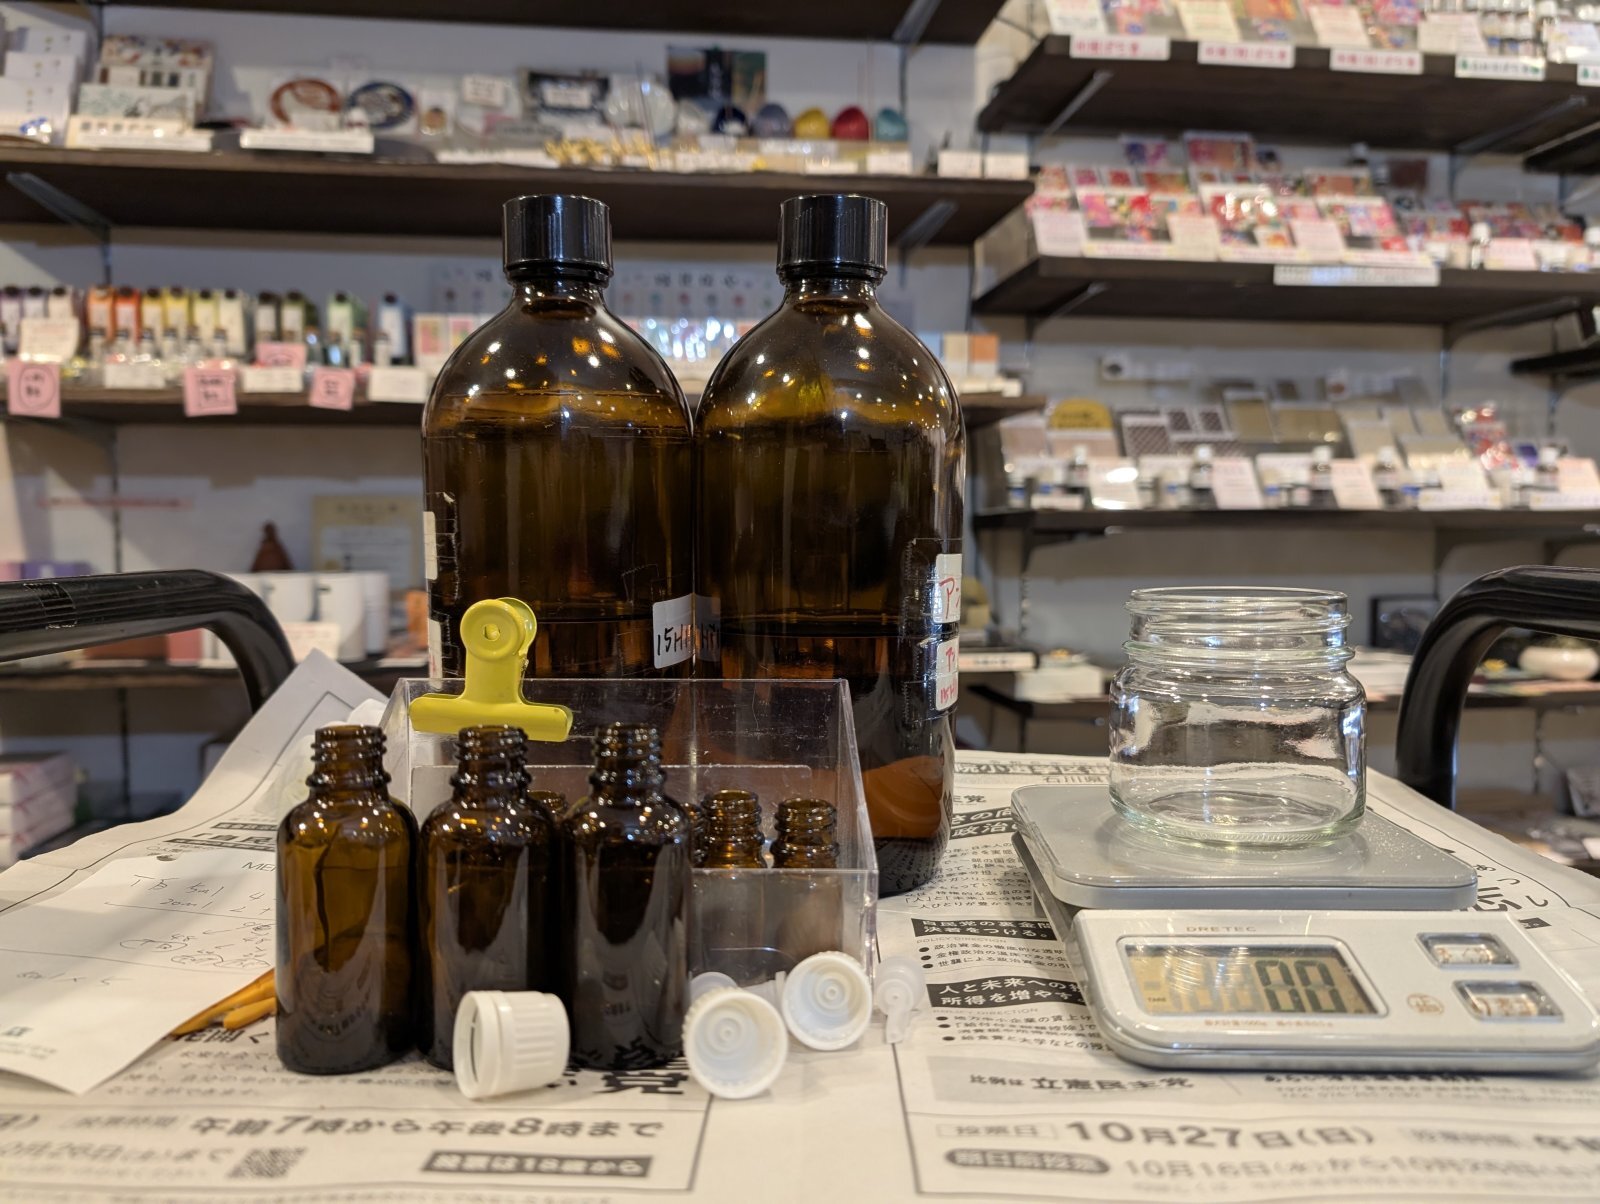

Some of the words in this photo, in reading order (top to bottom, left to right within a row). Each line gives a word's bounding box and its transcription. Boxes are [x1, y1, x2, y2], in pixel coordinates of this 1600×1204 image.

[1186, 925, 1257, 933] DRETEC
[1031, 1076, 1194, 1091] 立憲民主党
[189, 1115, 665, 1139] 午前7時から午後8時まで
